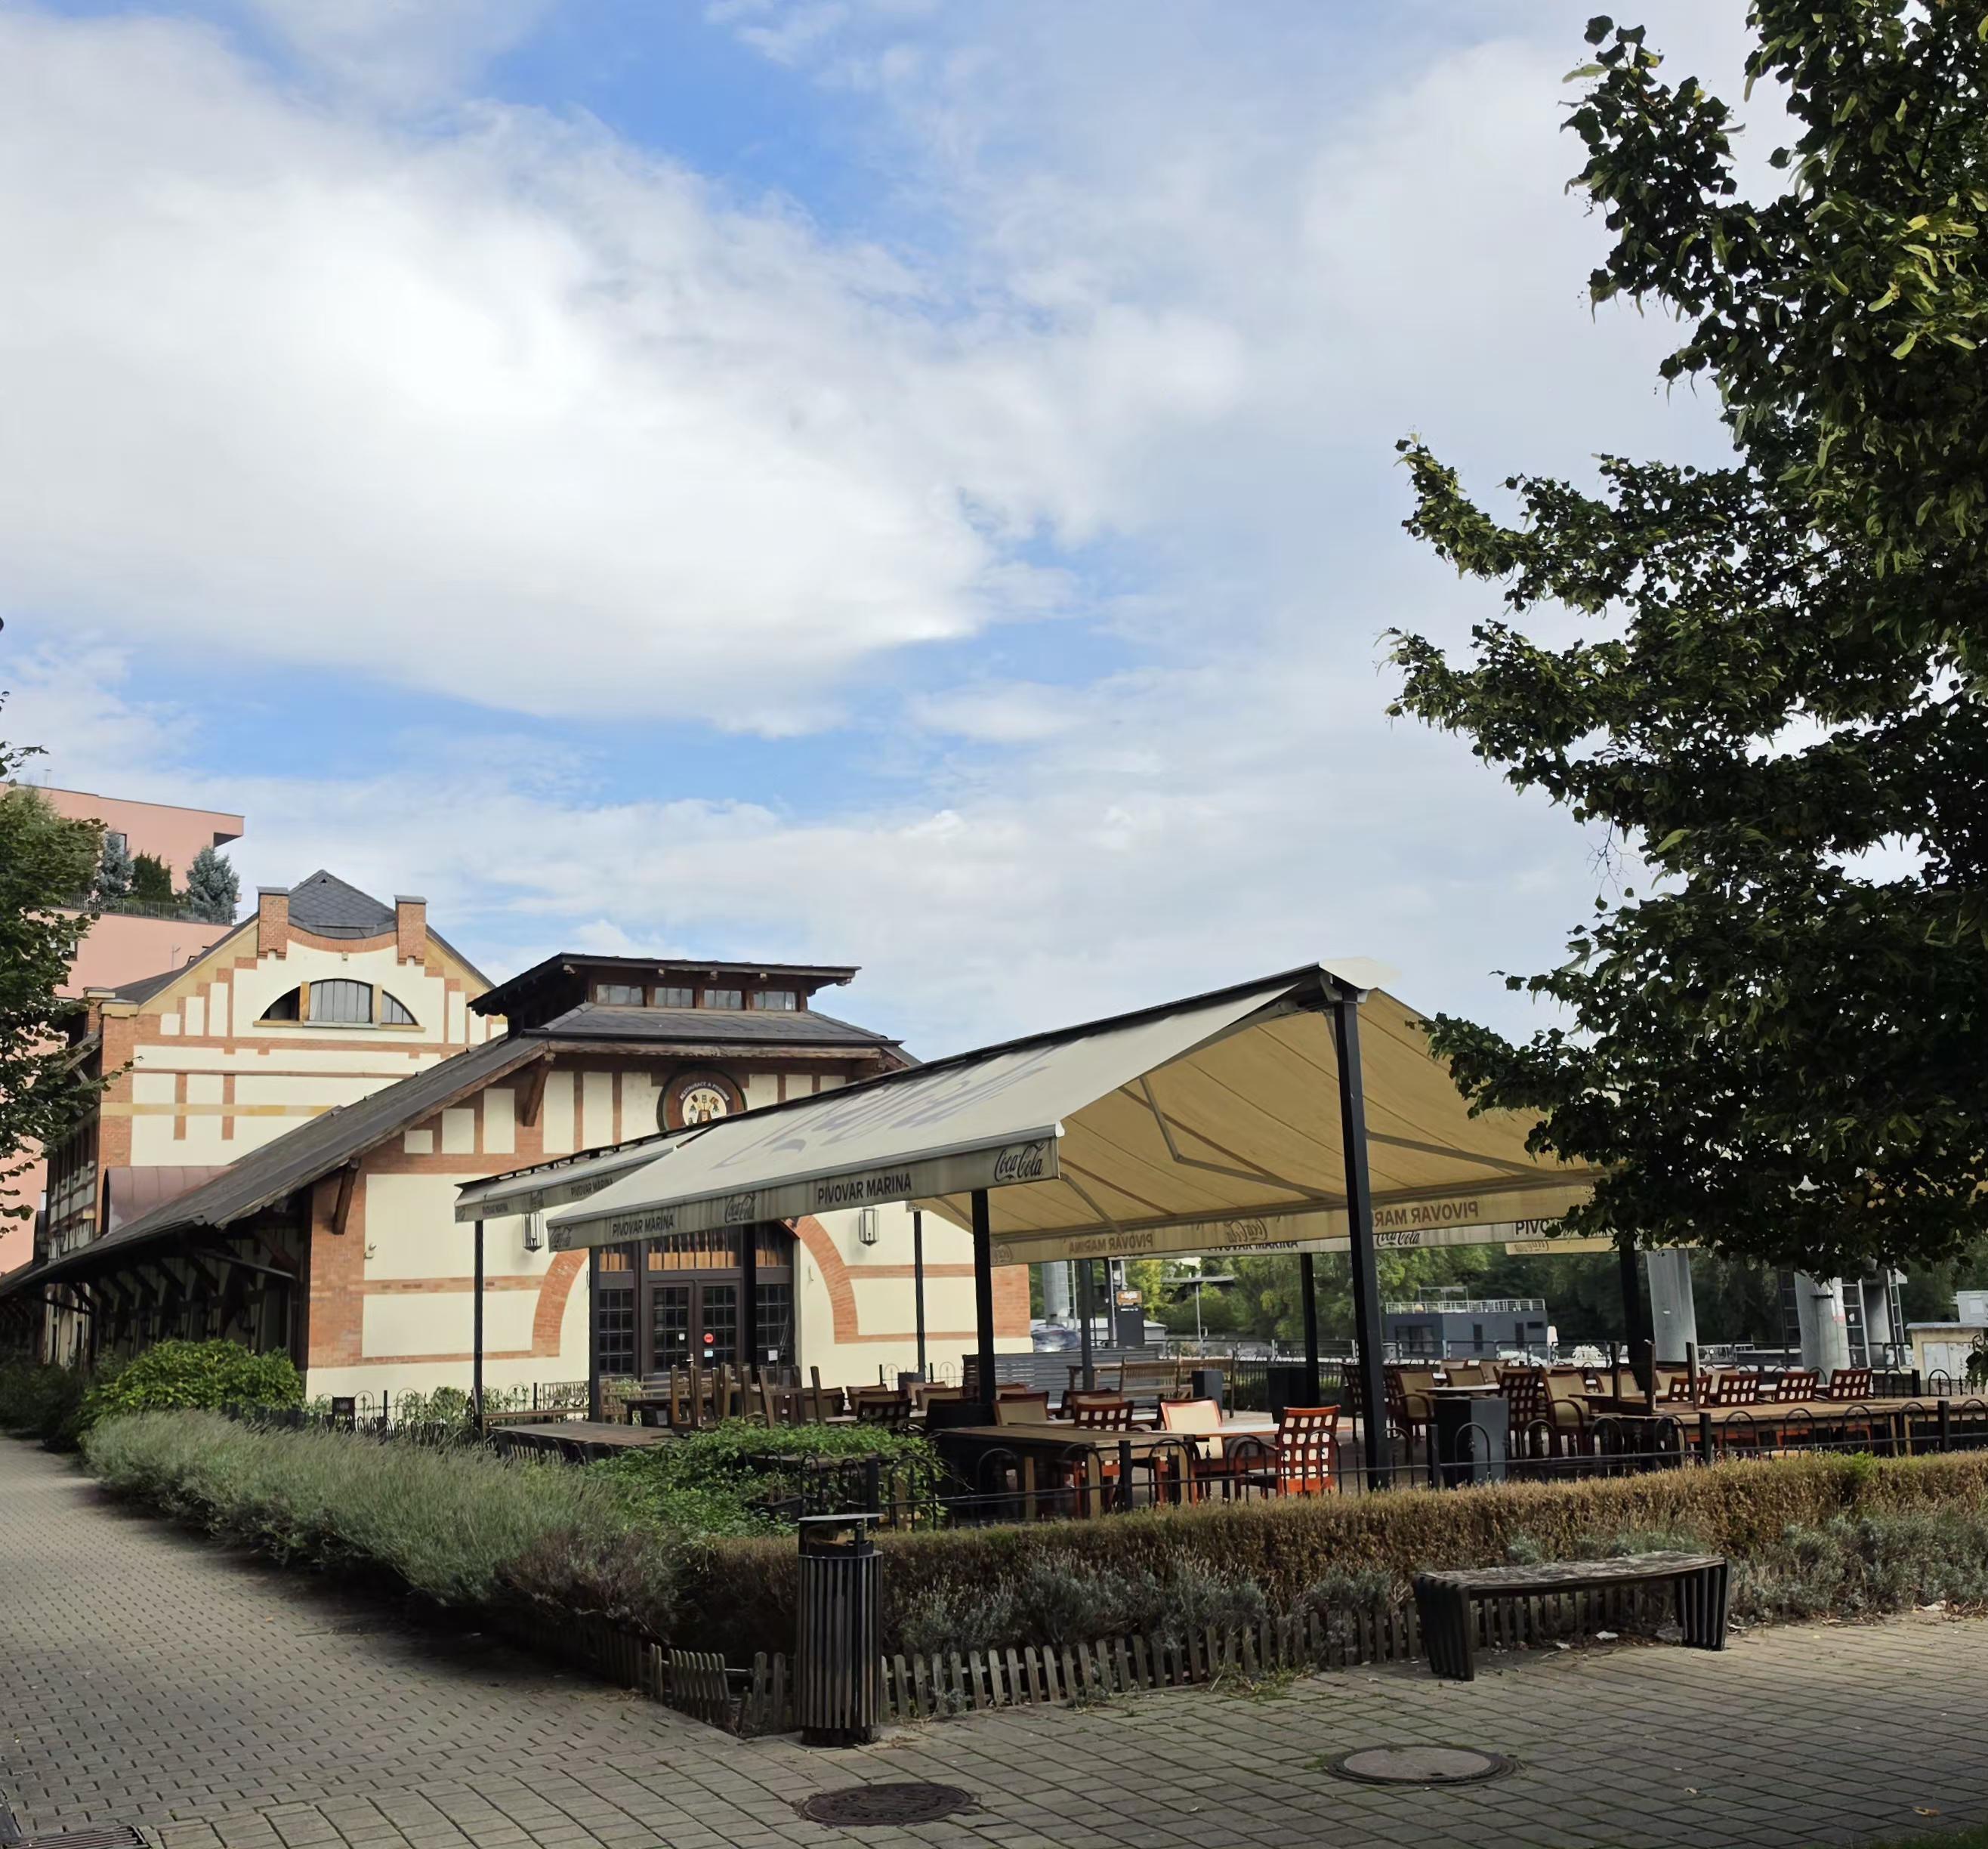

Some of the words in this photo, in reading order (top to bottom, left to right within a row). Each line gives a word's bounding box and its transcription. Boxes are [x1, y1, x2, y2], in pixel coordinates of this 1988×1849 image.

[994, 1142, 1047, 1183] Coca-Cola
[818, 1181, 864, 1205] PIVOVAR
[866, 1172, 912, 1198] MARINA
[612, 1218, 644, 1238] PIVOVAR
[644, 1214, 674, 1233] MARINA
